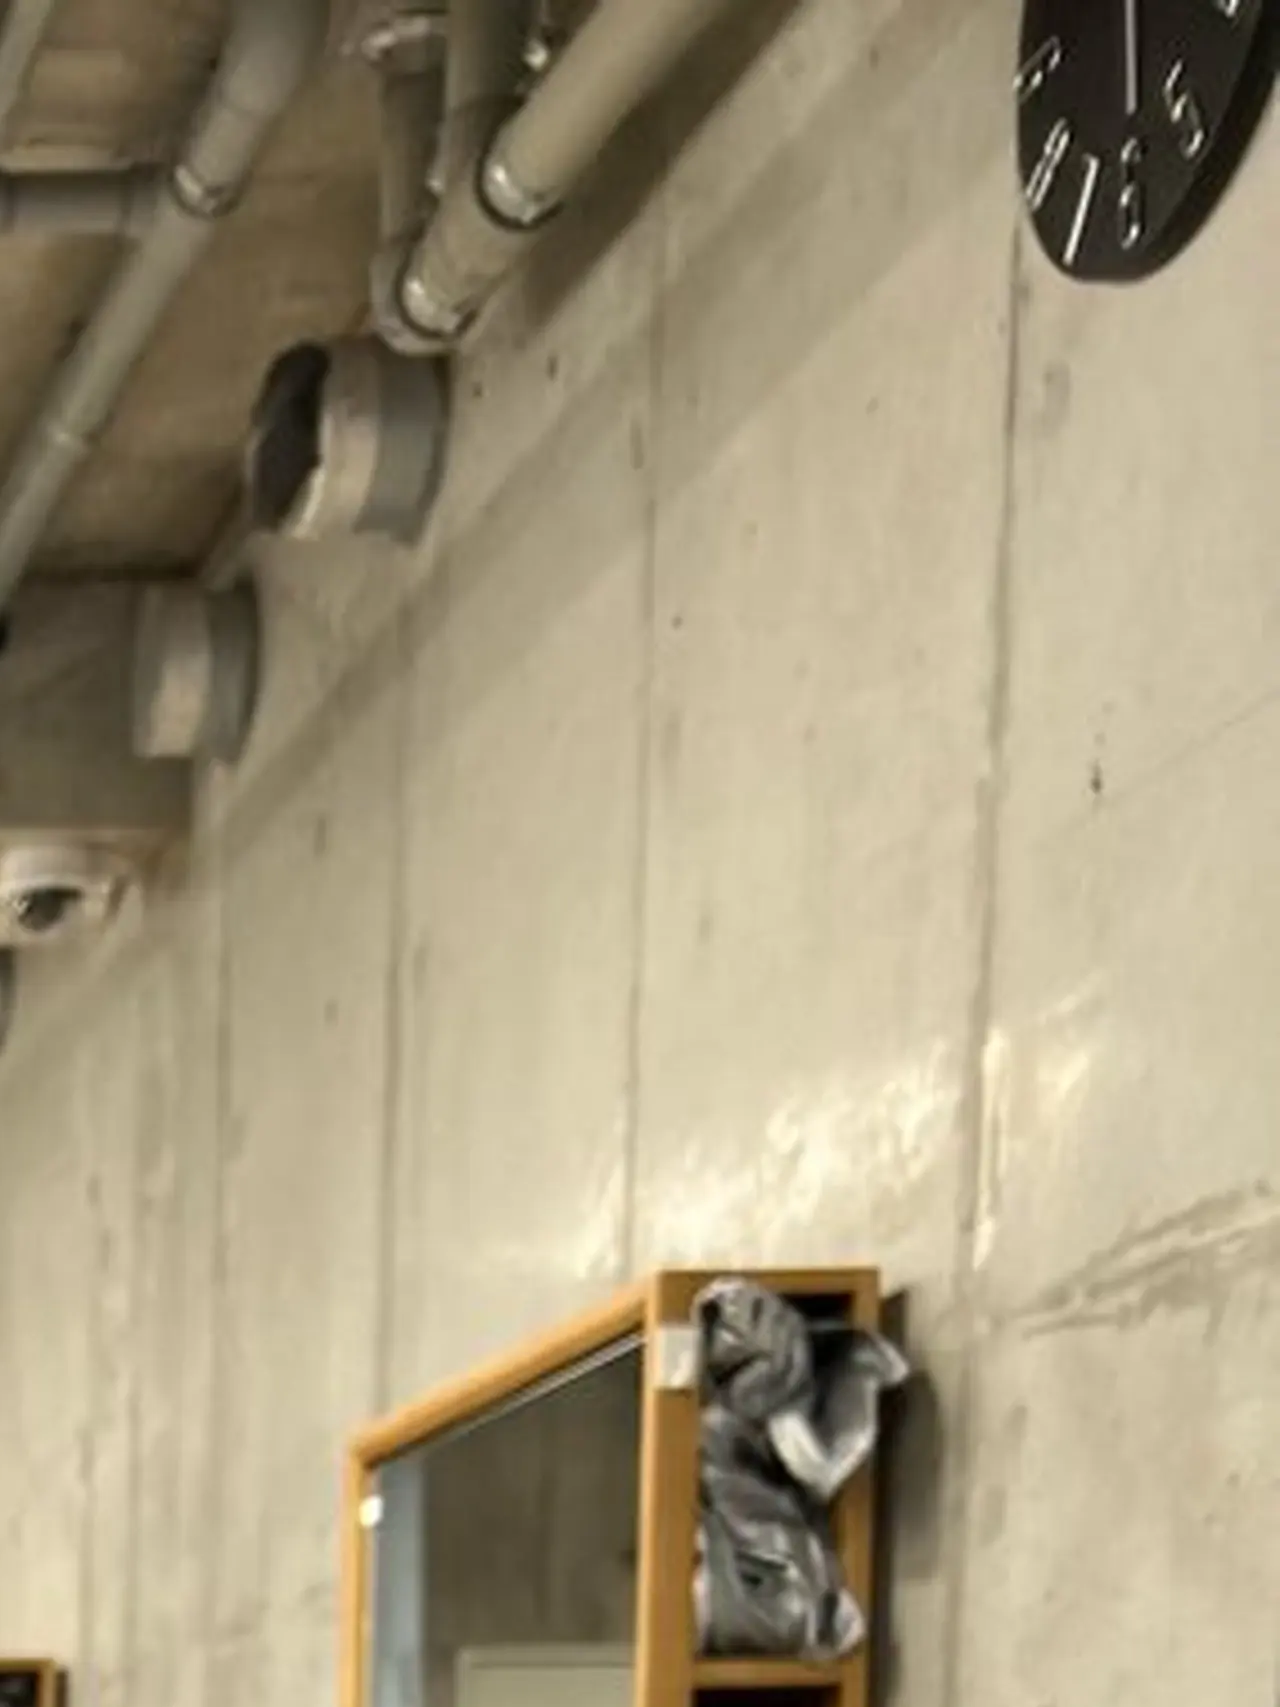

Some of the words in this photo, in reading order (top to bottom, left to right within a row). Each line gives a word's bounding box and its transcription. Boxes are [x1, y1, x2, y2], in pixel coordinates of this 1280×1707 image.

[1164, 60, 1206, 159] 5
[1026, 117, 1071, 211] 8
[1062, 153, 1100, 266] 7
[1119, 137, 1143, 249] 6
